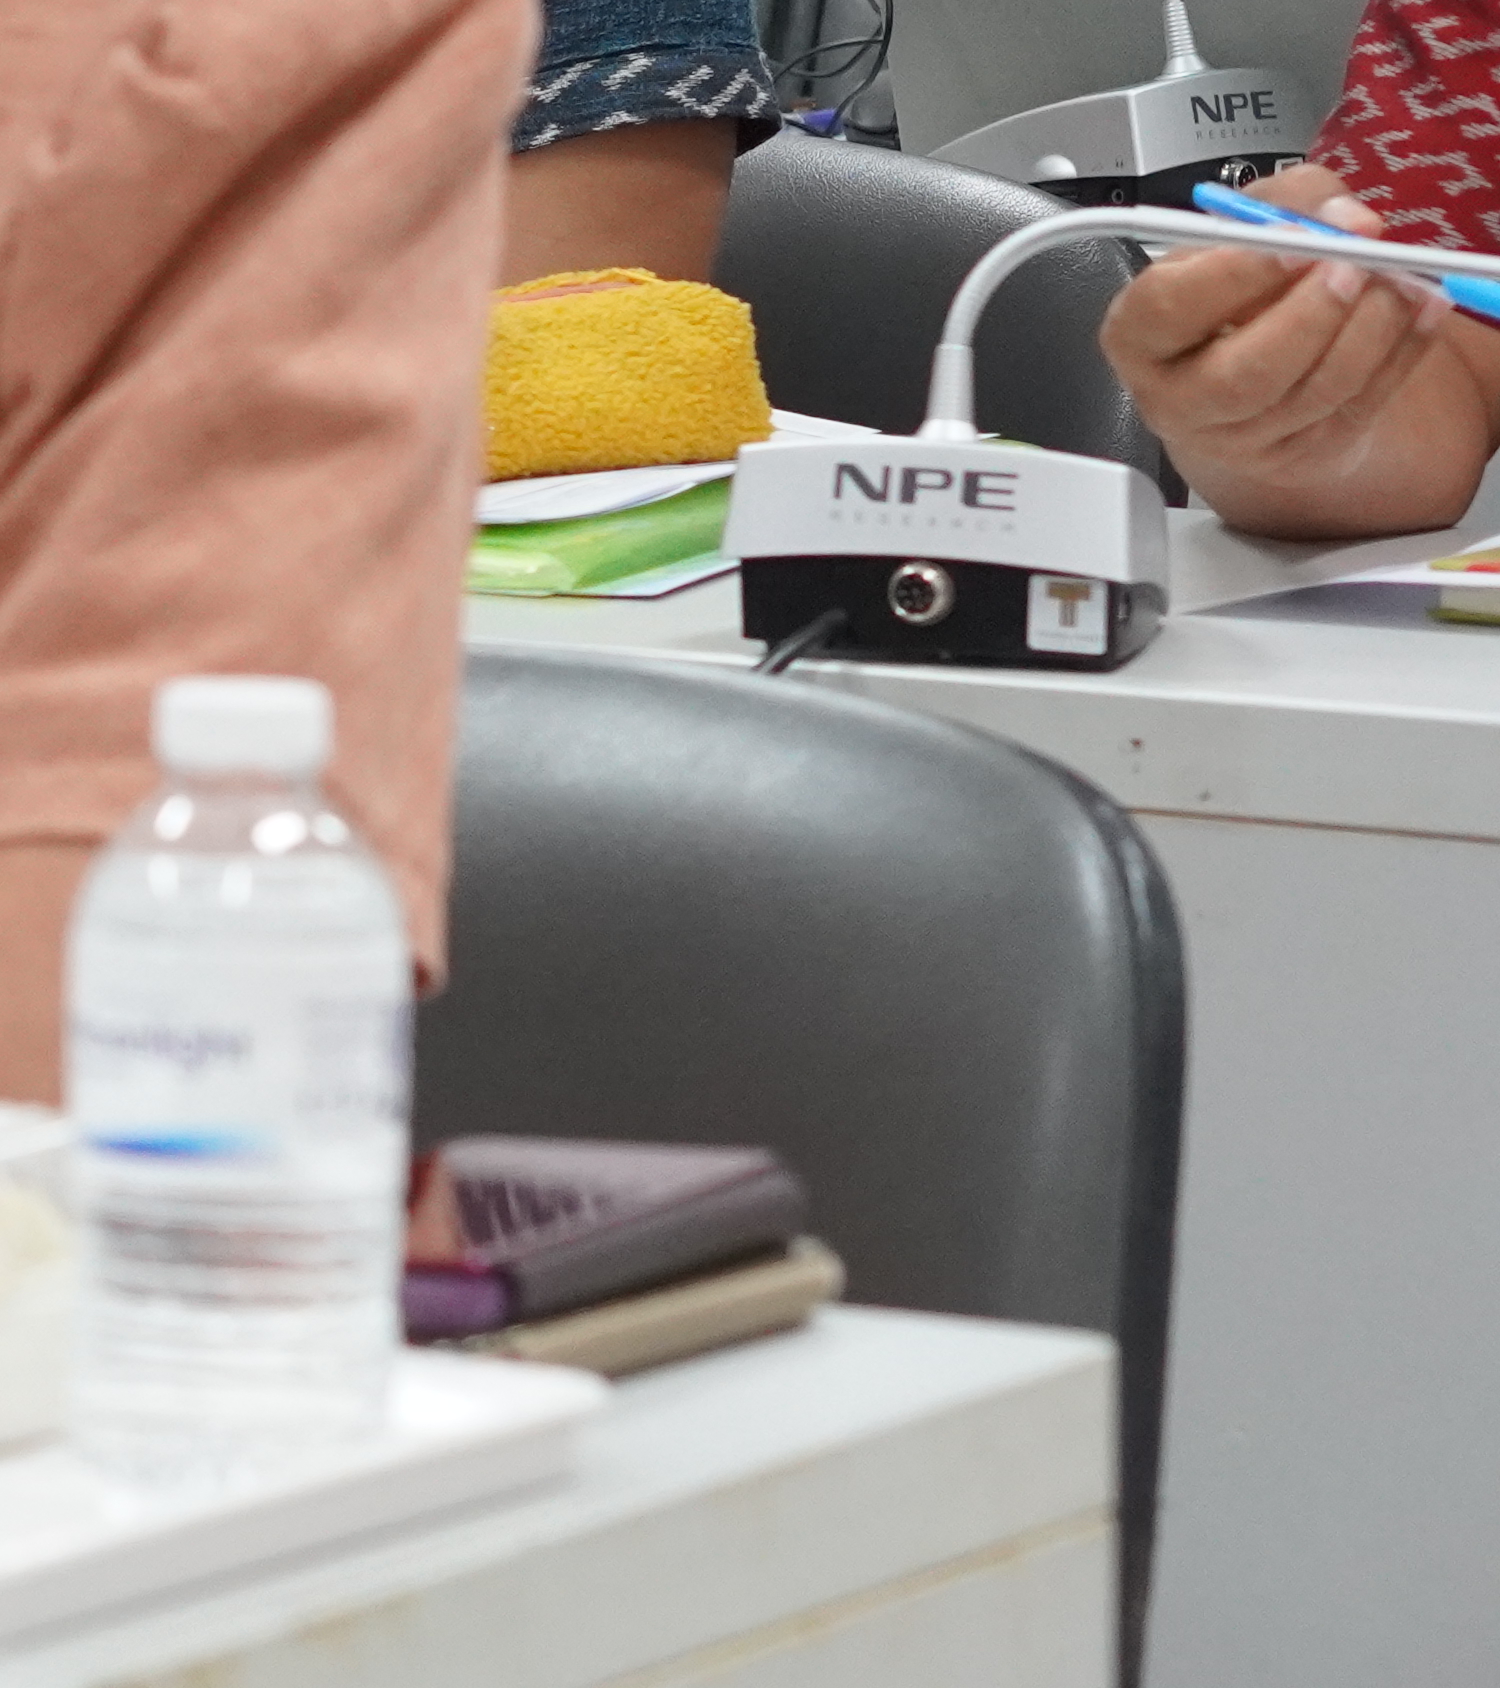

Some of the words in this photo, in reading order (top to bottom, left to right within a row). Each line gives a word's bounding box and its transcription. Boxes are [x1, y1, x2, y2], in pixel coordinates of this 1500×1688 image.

[1190, 90, 1278, 124] NPE
[1196, 126, 1282, 141] RESEARCH
[833, 463, 1019, 511] NPE
